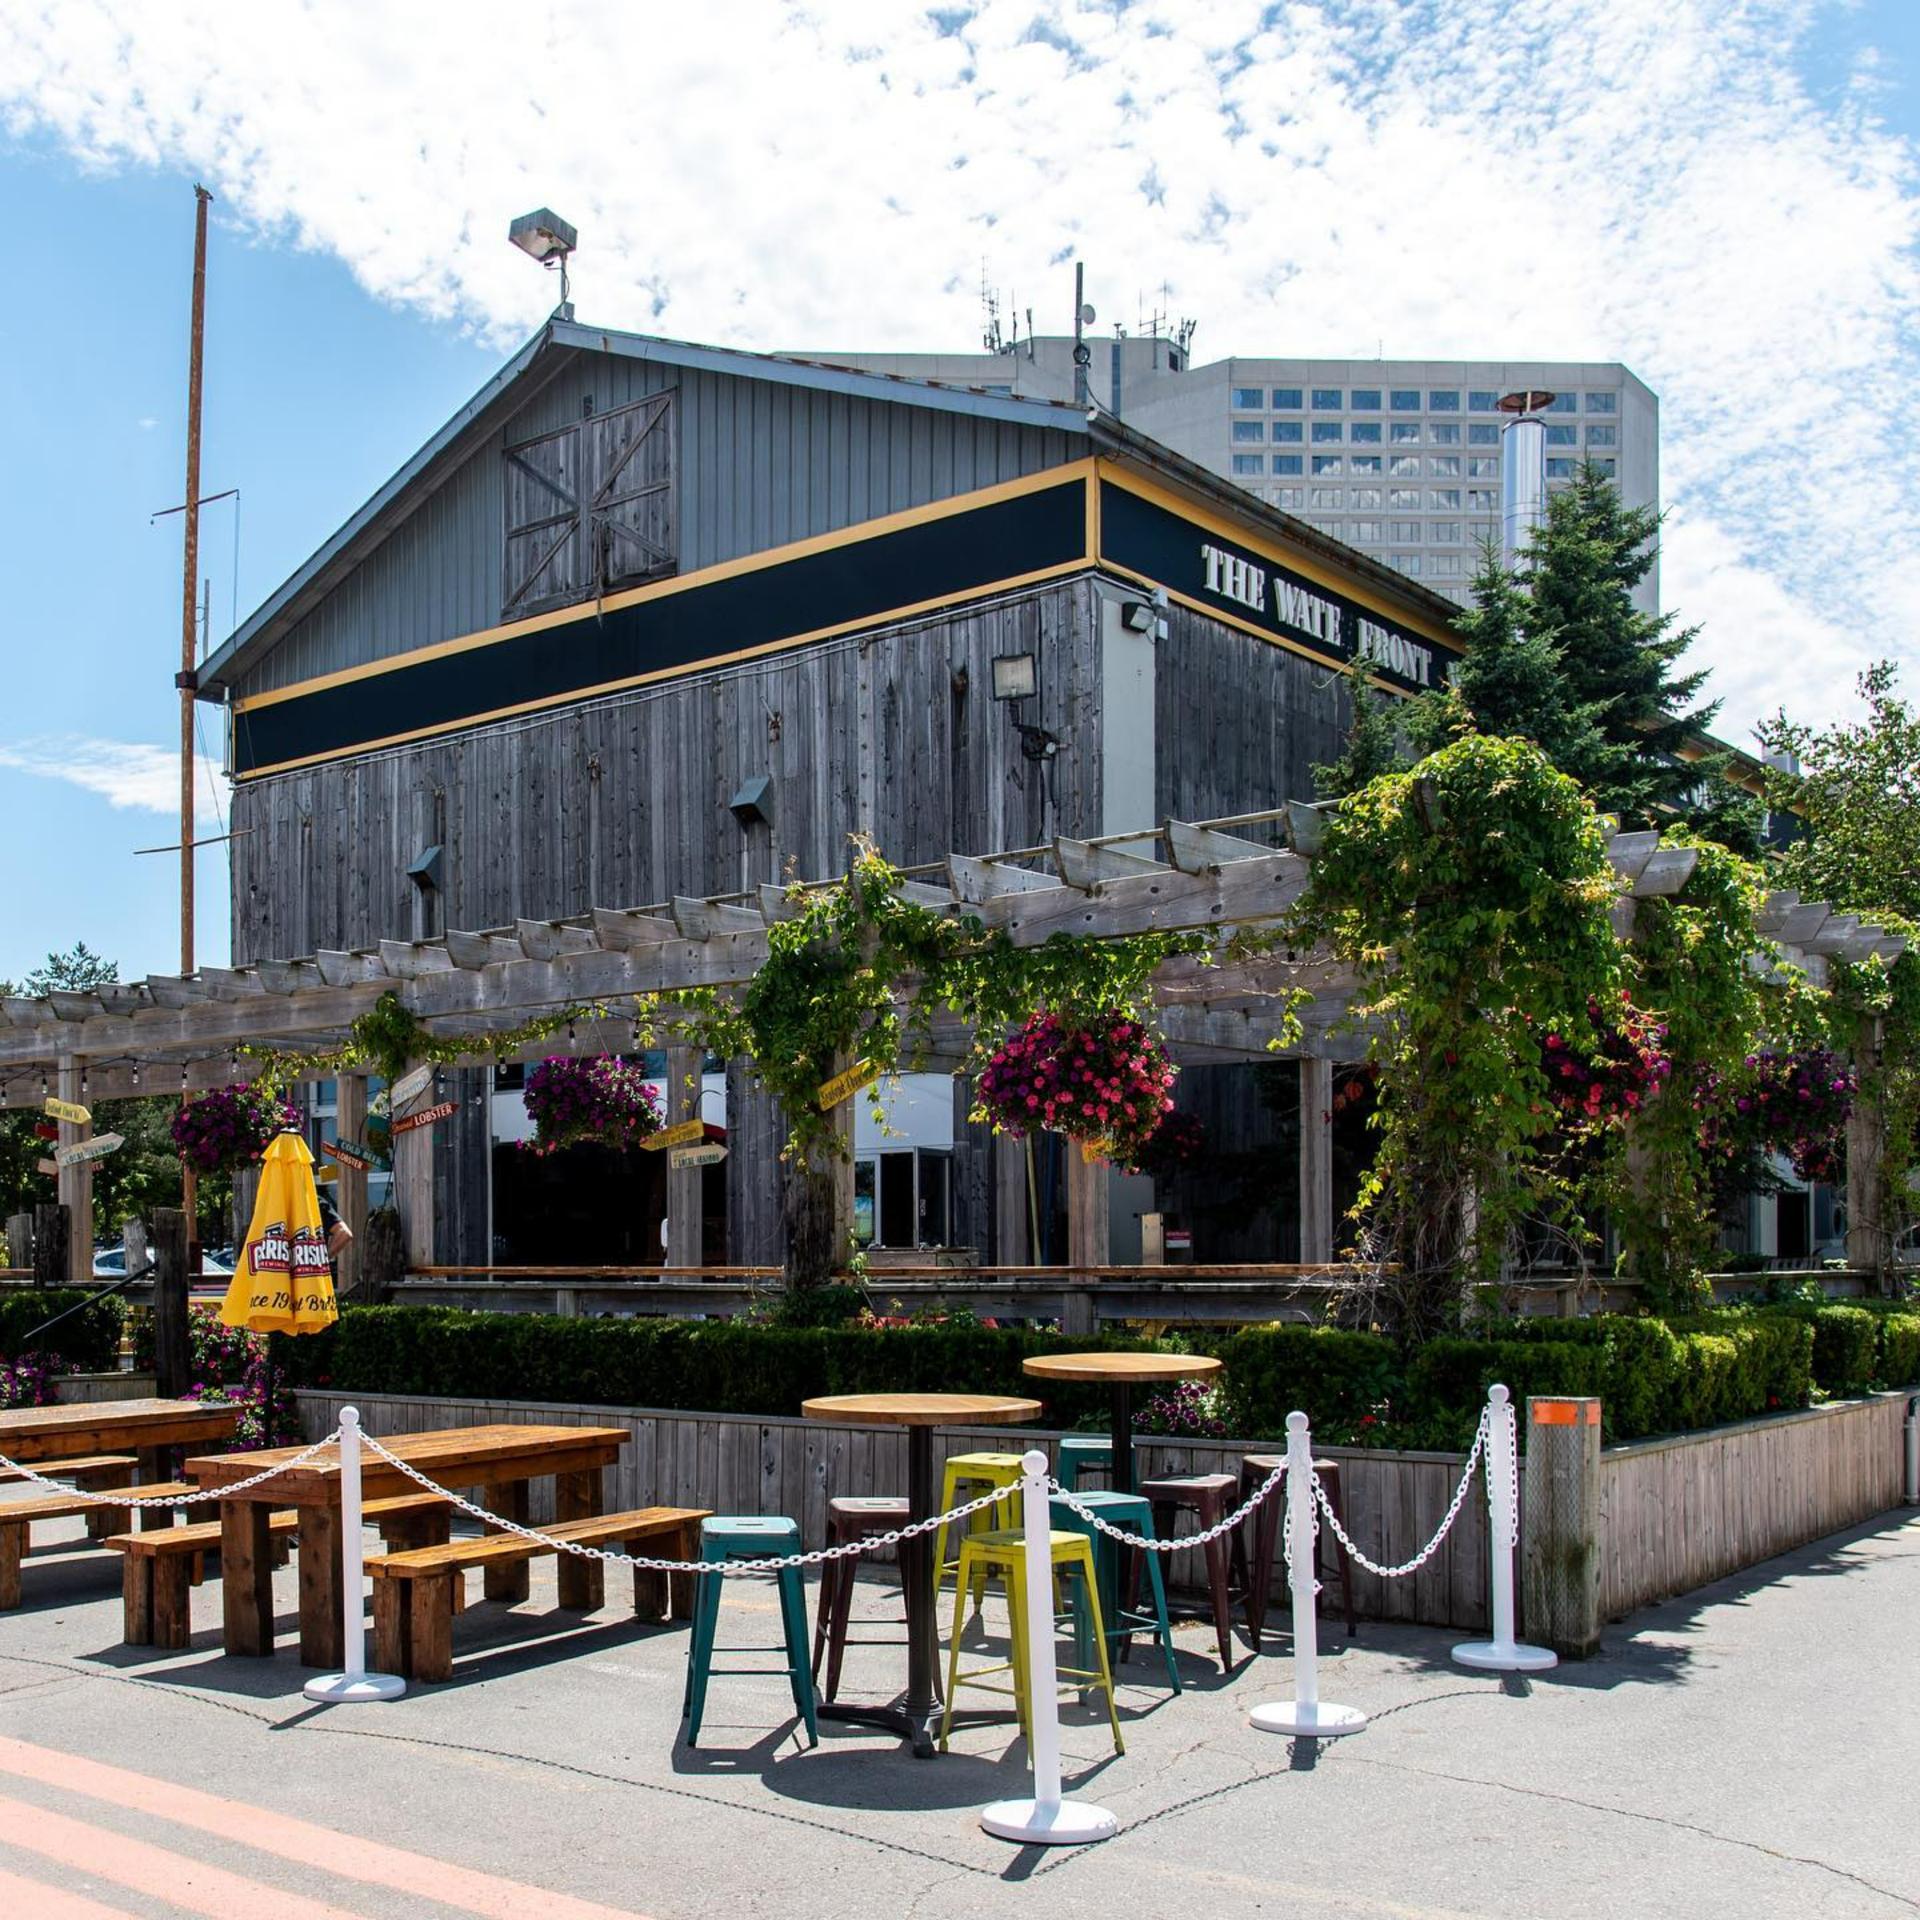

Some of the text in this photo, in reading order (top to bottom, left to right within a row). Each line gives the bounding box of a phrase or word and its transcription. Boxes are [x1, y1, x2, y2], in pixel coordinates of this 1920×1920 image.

[1201, 544, 1265, 612] THE
[414, 1104, 453, 1126] LOBSTER
[340, 1141, 361, 1156] COLD
[336, 1151, 364, 1170] LOBSTER
